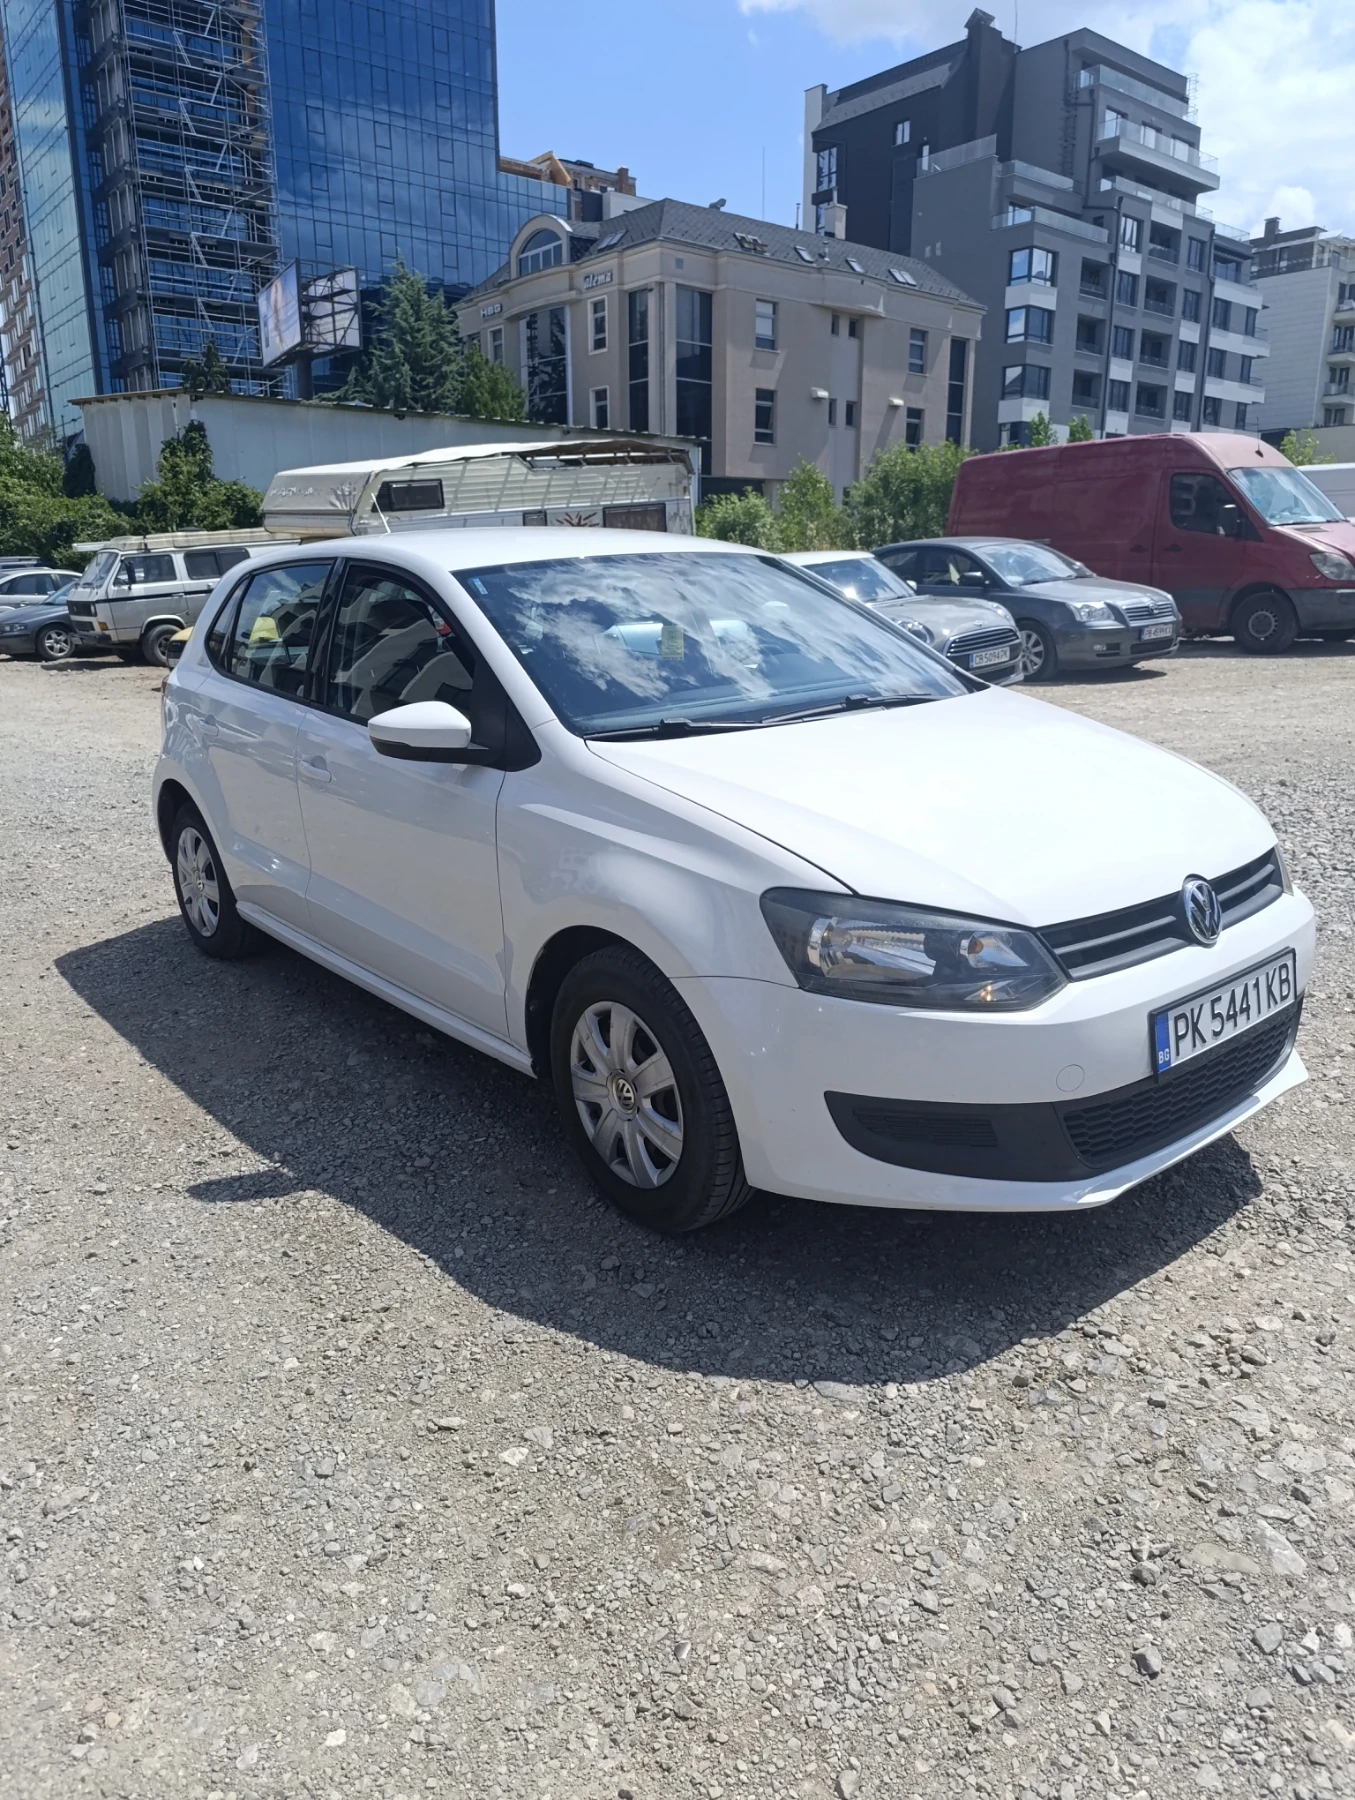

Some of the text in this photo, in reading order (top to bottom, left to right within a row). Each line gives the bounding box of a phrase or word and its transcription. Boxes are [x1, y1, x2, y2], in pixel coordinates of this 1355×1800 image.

[480, 304, 501, 318] HBG
[1173, 962, 1292, 1056] PK 5441 KB
[1158, 1048, 1170, 1065] BG
